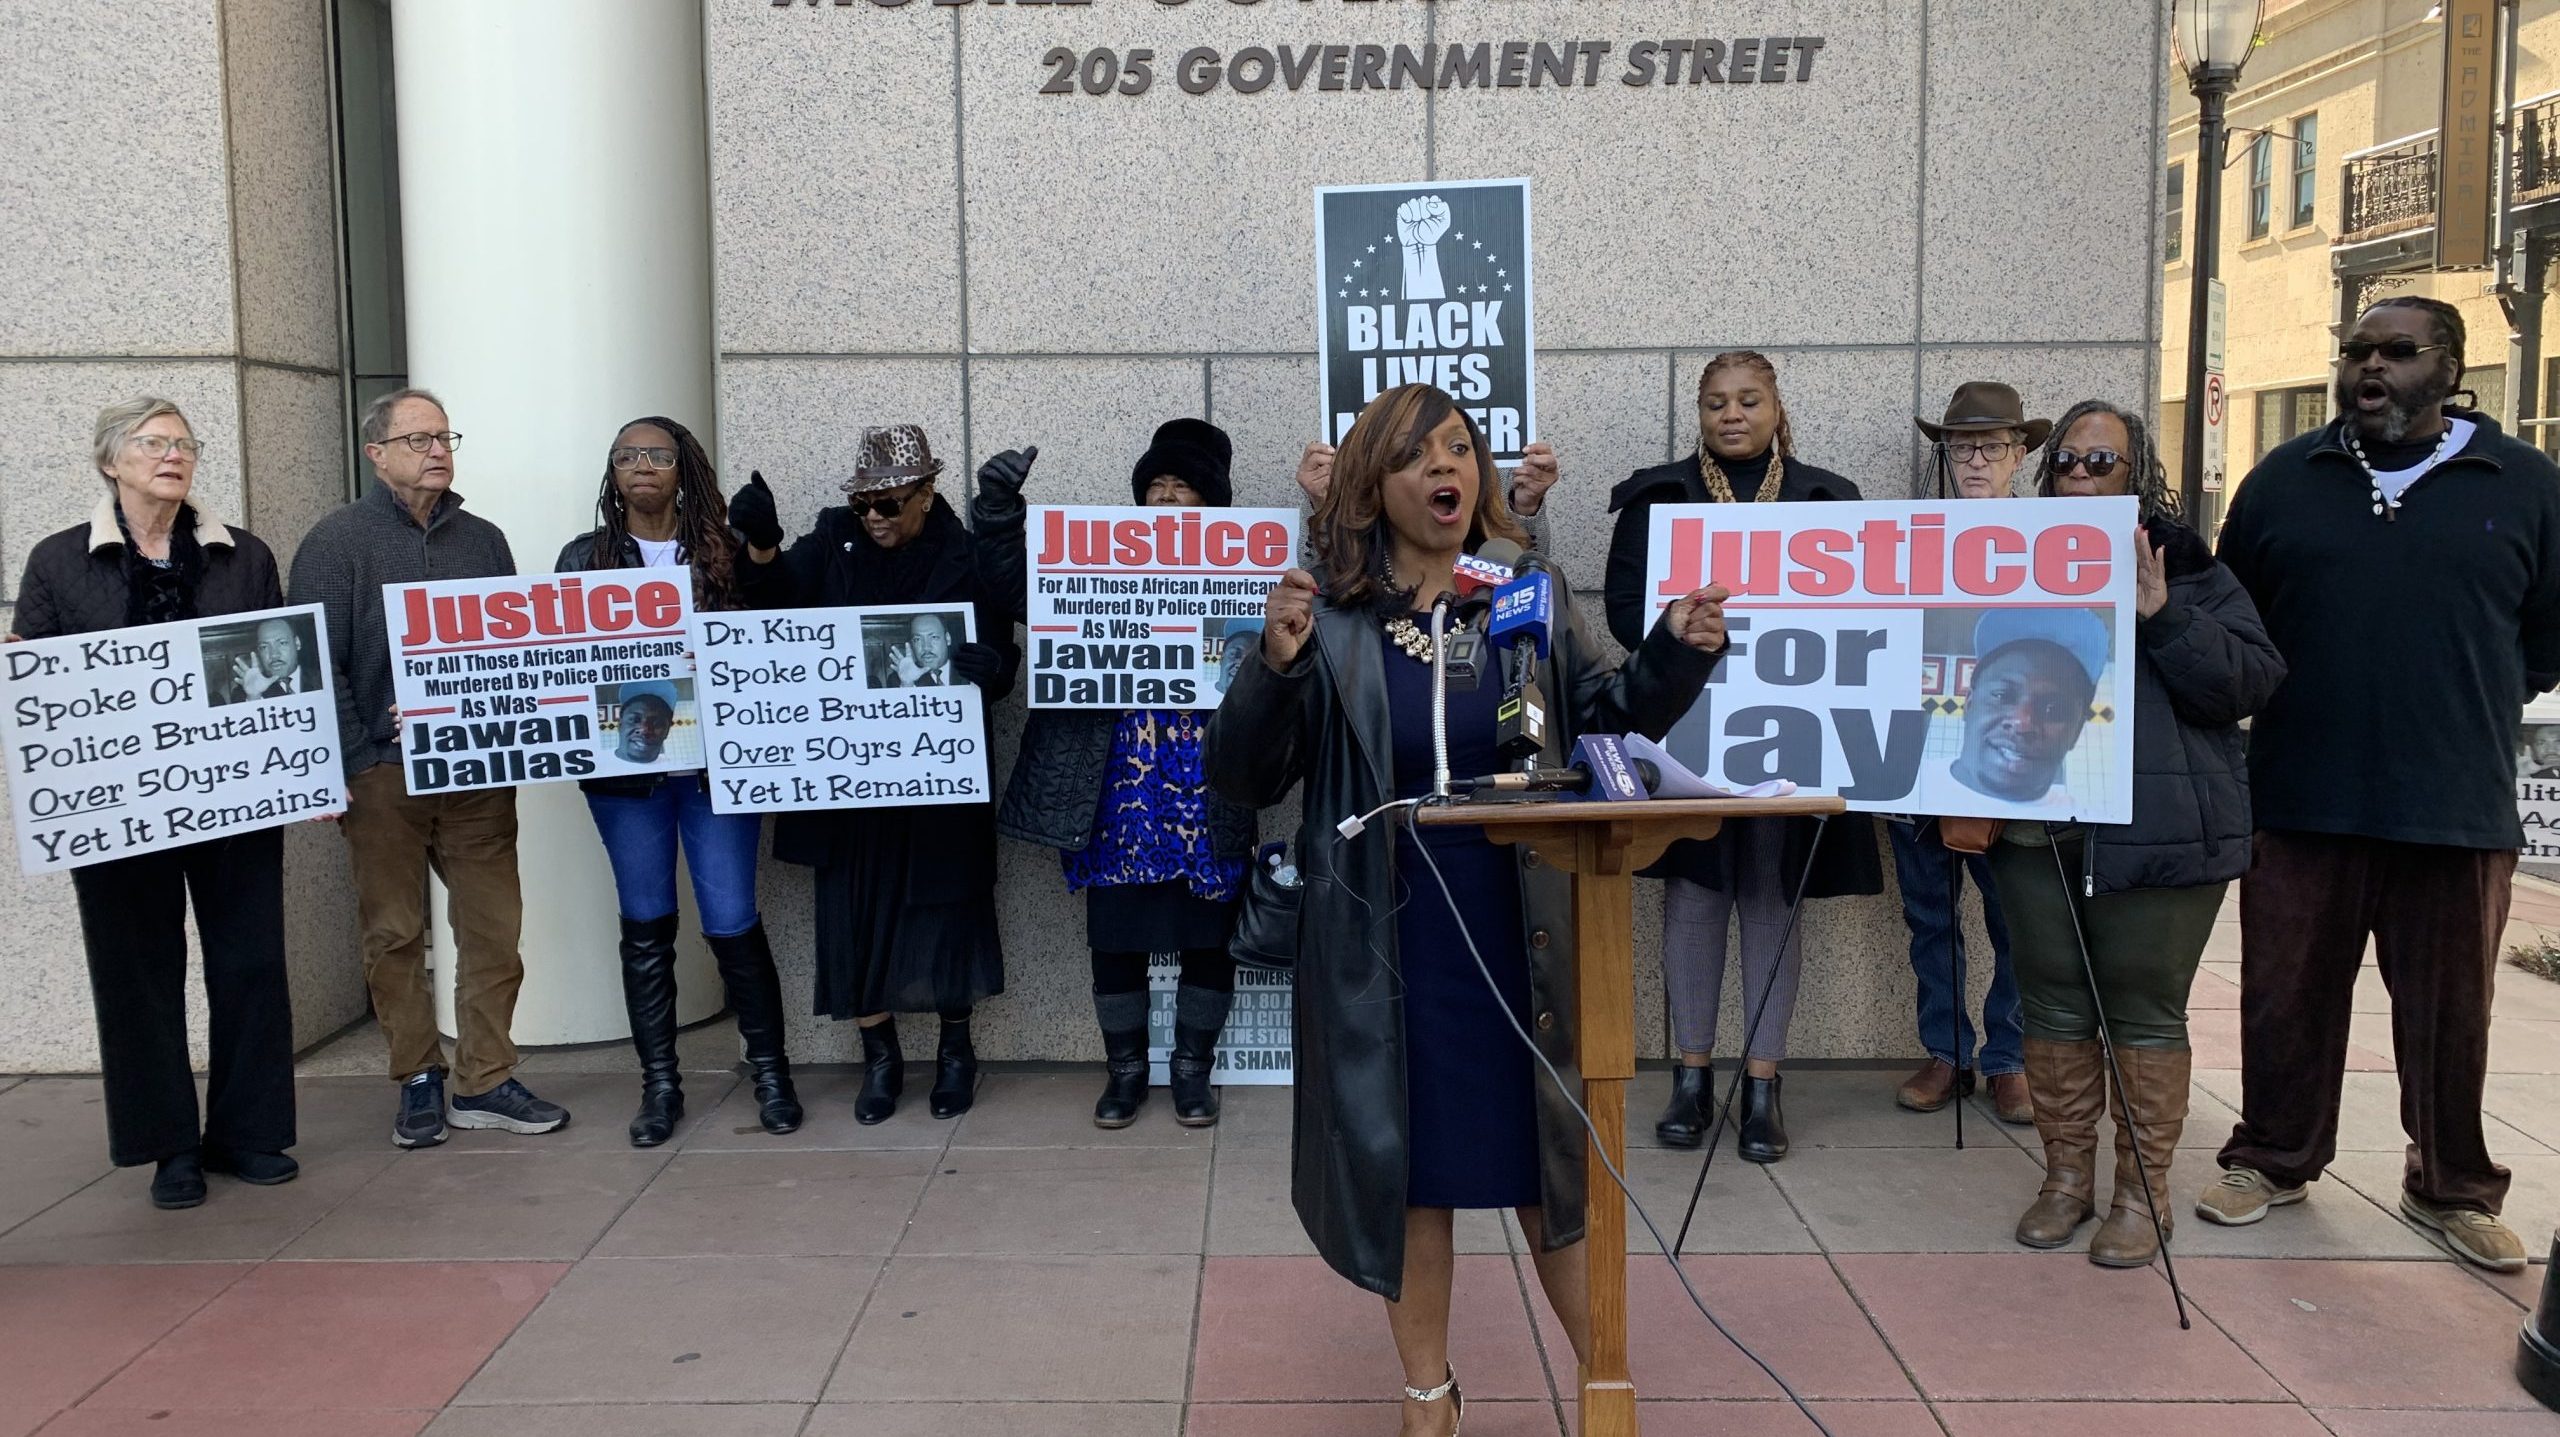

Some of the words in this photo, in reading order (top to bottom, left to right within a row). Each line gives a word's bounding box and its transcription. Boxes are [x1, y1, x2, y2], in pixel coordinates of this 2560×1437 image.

[1038, 46, 1154, 96] 205
[1176, 41, 1611, 94] GOVERNMENT
[1620, 36, 1826, 88] STREET
[2462, 47, 2481, 55] THE
[1347, 300, 1505, 351] BLACK
[1362, 353, 1491, 403] LIVES
[1037, 510, 1288, 567] Justice
[1657, 513, 2112, 597] Justice
[1038, 577, 1063, 594] For
[1066, 577, 1087, 594] All
[1089, 577, 1139, 595] Those
[1141, 578, 1199, 595] African
[1201, 578, 1279, 596] American
[1464, 569, 1503, 584] NEW
[401, 577, 682, 647] Justice
[1053, 598, 1131, 616] Murdered
[1134, 598, 1154, 617] By
[1157, 599, 1207, 616] Police
[1496, 603, 1531, 621] NEWS
[1512, 585, 1535, 607] 15
[703, 620, 753, 647] Dr.
[762, 617, 836, 650] King
[1082, 619, 1105, 639] As
[1107, 620, 1150, 639] Was
[6, 651, 70, 681] Dr.
[80, 639, 170, 670] King
[404, 658, 434, 677] For
[437, 655, 461, 674] All
[464, 652, 519, 672] Those
[523, 647, 589, 667] African
[590, 640, 685, 664] Americans
[1034, 638, 1195, 670] Jawan
[424, 673, 514, 698] Murdered
[517, 671, 539, 692] By
[543, 666, 598, 687] Police
[601, 662, 671, 682] Officers
[710, 659, 806, 694] Spoke
[817, 655, 857, 682] Of
[1034, 673, 1197, 704] Dallas
[15, 688, 136, 732] Spoke
[150, 673, 196, 705] Of
[461, 698, 486, 719] As
[489, 695, 538, 717] Was
[713, 701, 810, 727] Police
[819, 694, 963, 723] Brutality
[19, 734, 141, 773] Police
[152, 706, 316, 751] Brutality
[410, 712, 590, 756] Jawan
[719, 740, 794, 765] Over
[805, 736, 901, 766] 50yrs
[911, 732, 975, 764] Ago
[412, 748, 596, 791] Dallas
[1603, 737, 1626, 771] NEWS
[29, 782, 124, 818] Over
[137, 760, 249, 797] 50yrs
[260, 745, 330, 777] Ago
[721, 778, 783, 806] Yet
[791, 776, 818, 803] It
[826, 772, 981, 802] Remains.
[33, 828, 111, 863] Yet
[121, 817, 154, 847] It
[164, 786, 338, 839] Remains.
[1238, 970, 1293, 986] TOWERS
[1259, 993, 1278, 1009] 80
[1152, 1010, 1173, 1027] 90
[1225, 1028, 1254, 1044] THE
[1216, 1051, 1230, 1070] A
[1234, 1050, 1292, 1071] SHAM
